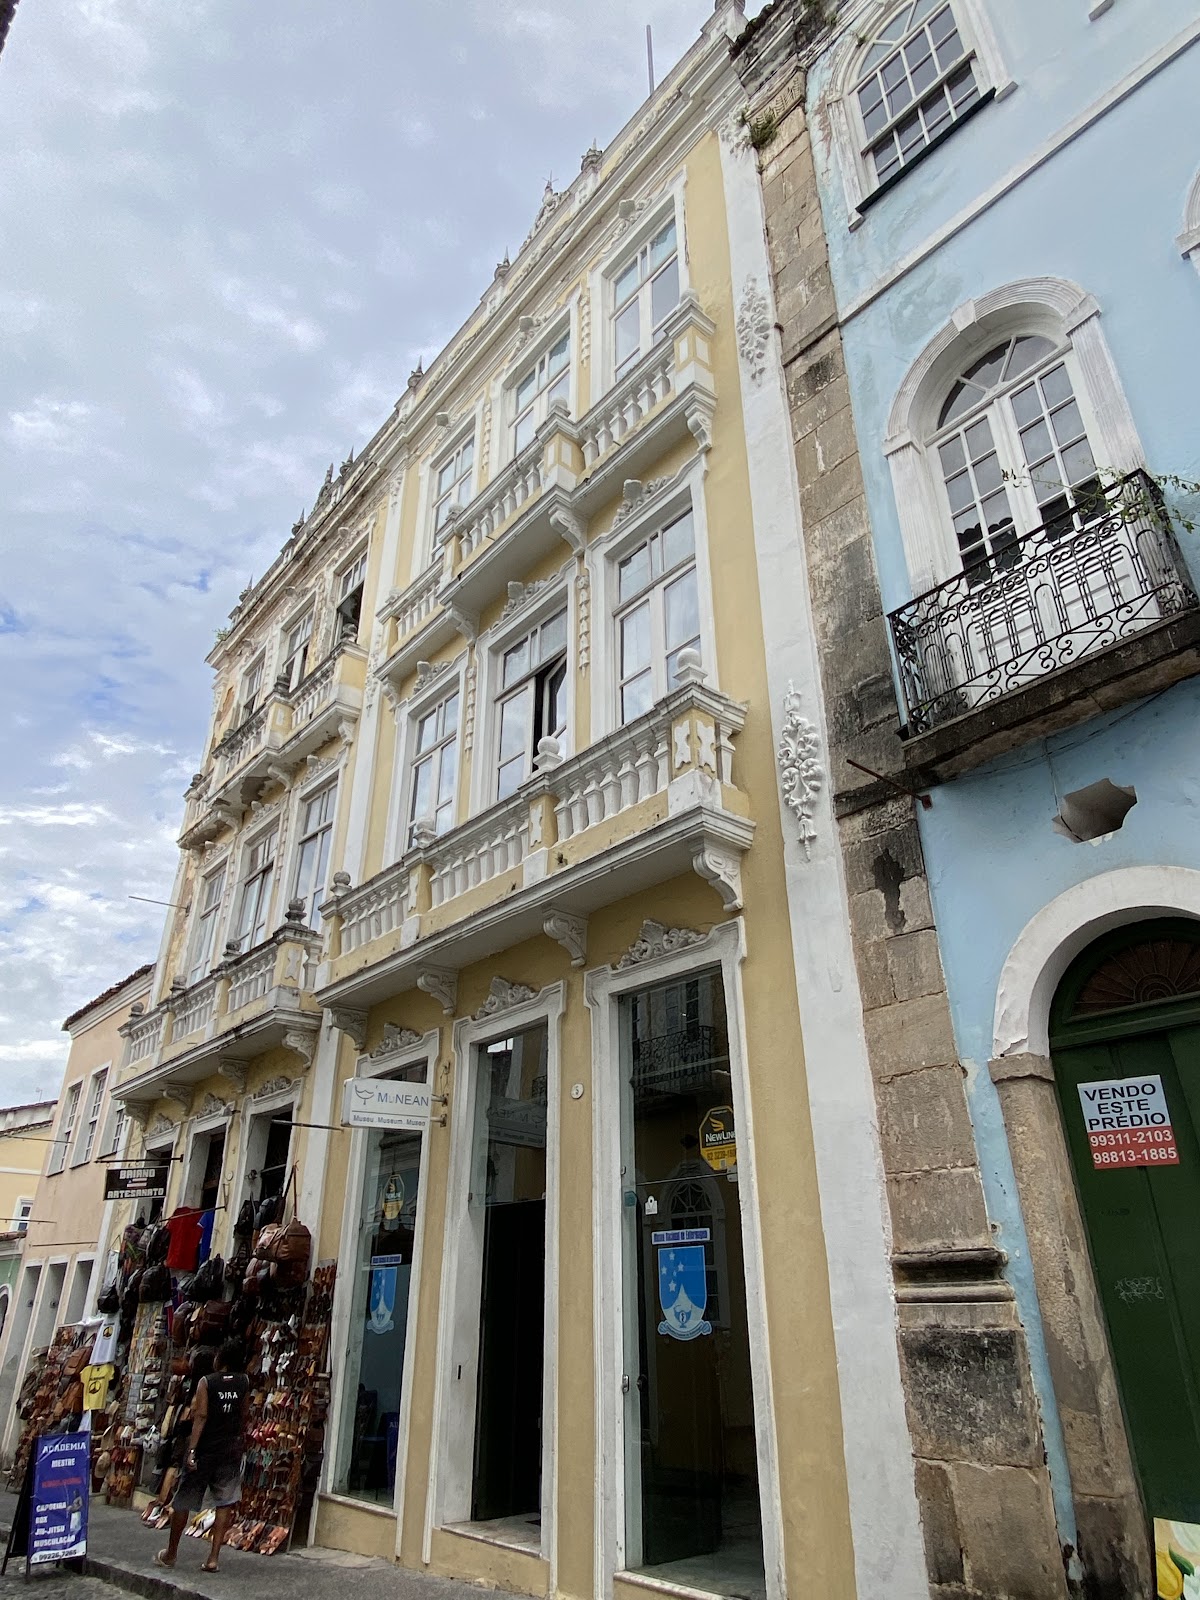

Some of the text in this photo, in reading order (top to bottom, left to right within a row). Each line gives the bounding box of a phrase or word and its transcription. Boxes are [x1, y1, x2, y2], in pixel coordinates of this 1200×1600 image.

[1083, 1083, 1156, 1102] VENDO
[1097, 1098, 1151, 1115] ESTE
[353, 1115, 426, 1127] Museu Museum Museo
[1088, 1112, 1166, 1131] PRÉDIO
[1089, 1129, 1173, 1147] 99311-2103
[1092, 1146, 1178, 1164] 98813-1885
[119, 1169, 156, 1180] BAIANO
[107, 1187, 165, 1199] ARTESANATO
[42, 1441, 87, 1454] ACADEMIA
[51, 1457, 76, 1468] MESTRE
[36, 1501, 67, 1513] CAPOEIRA
[34, 1525, 65, 1536] JIU-JITSU
[33, 1534, 76, 1548] MUSCULAÇÃO
